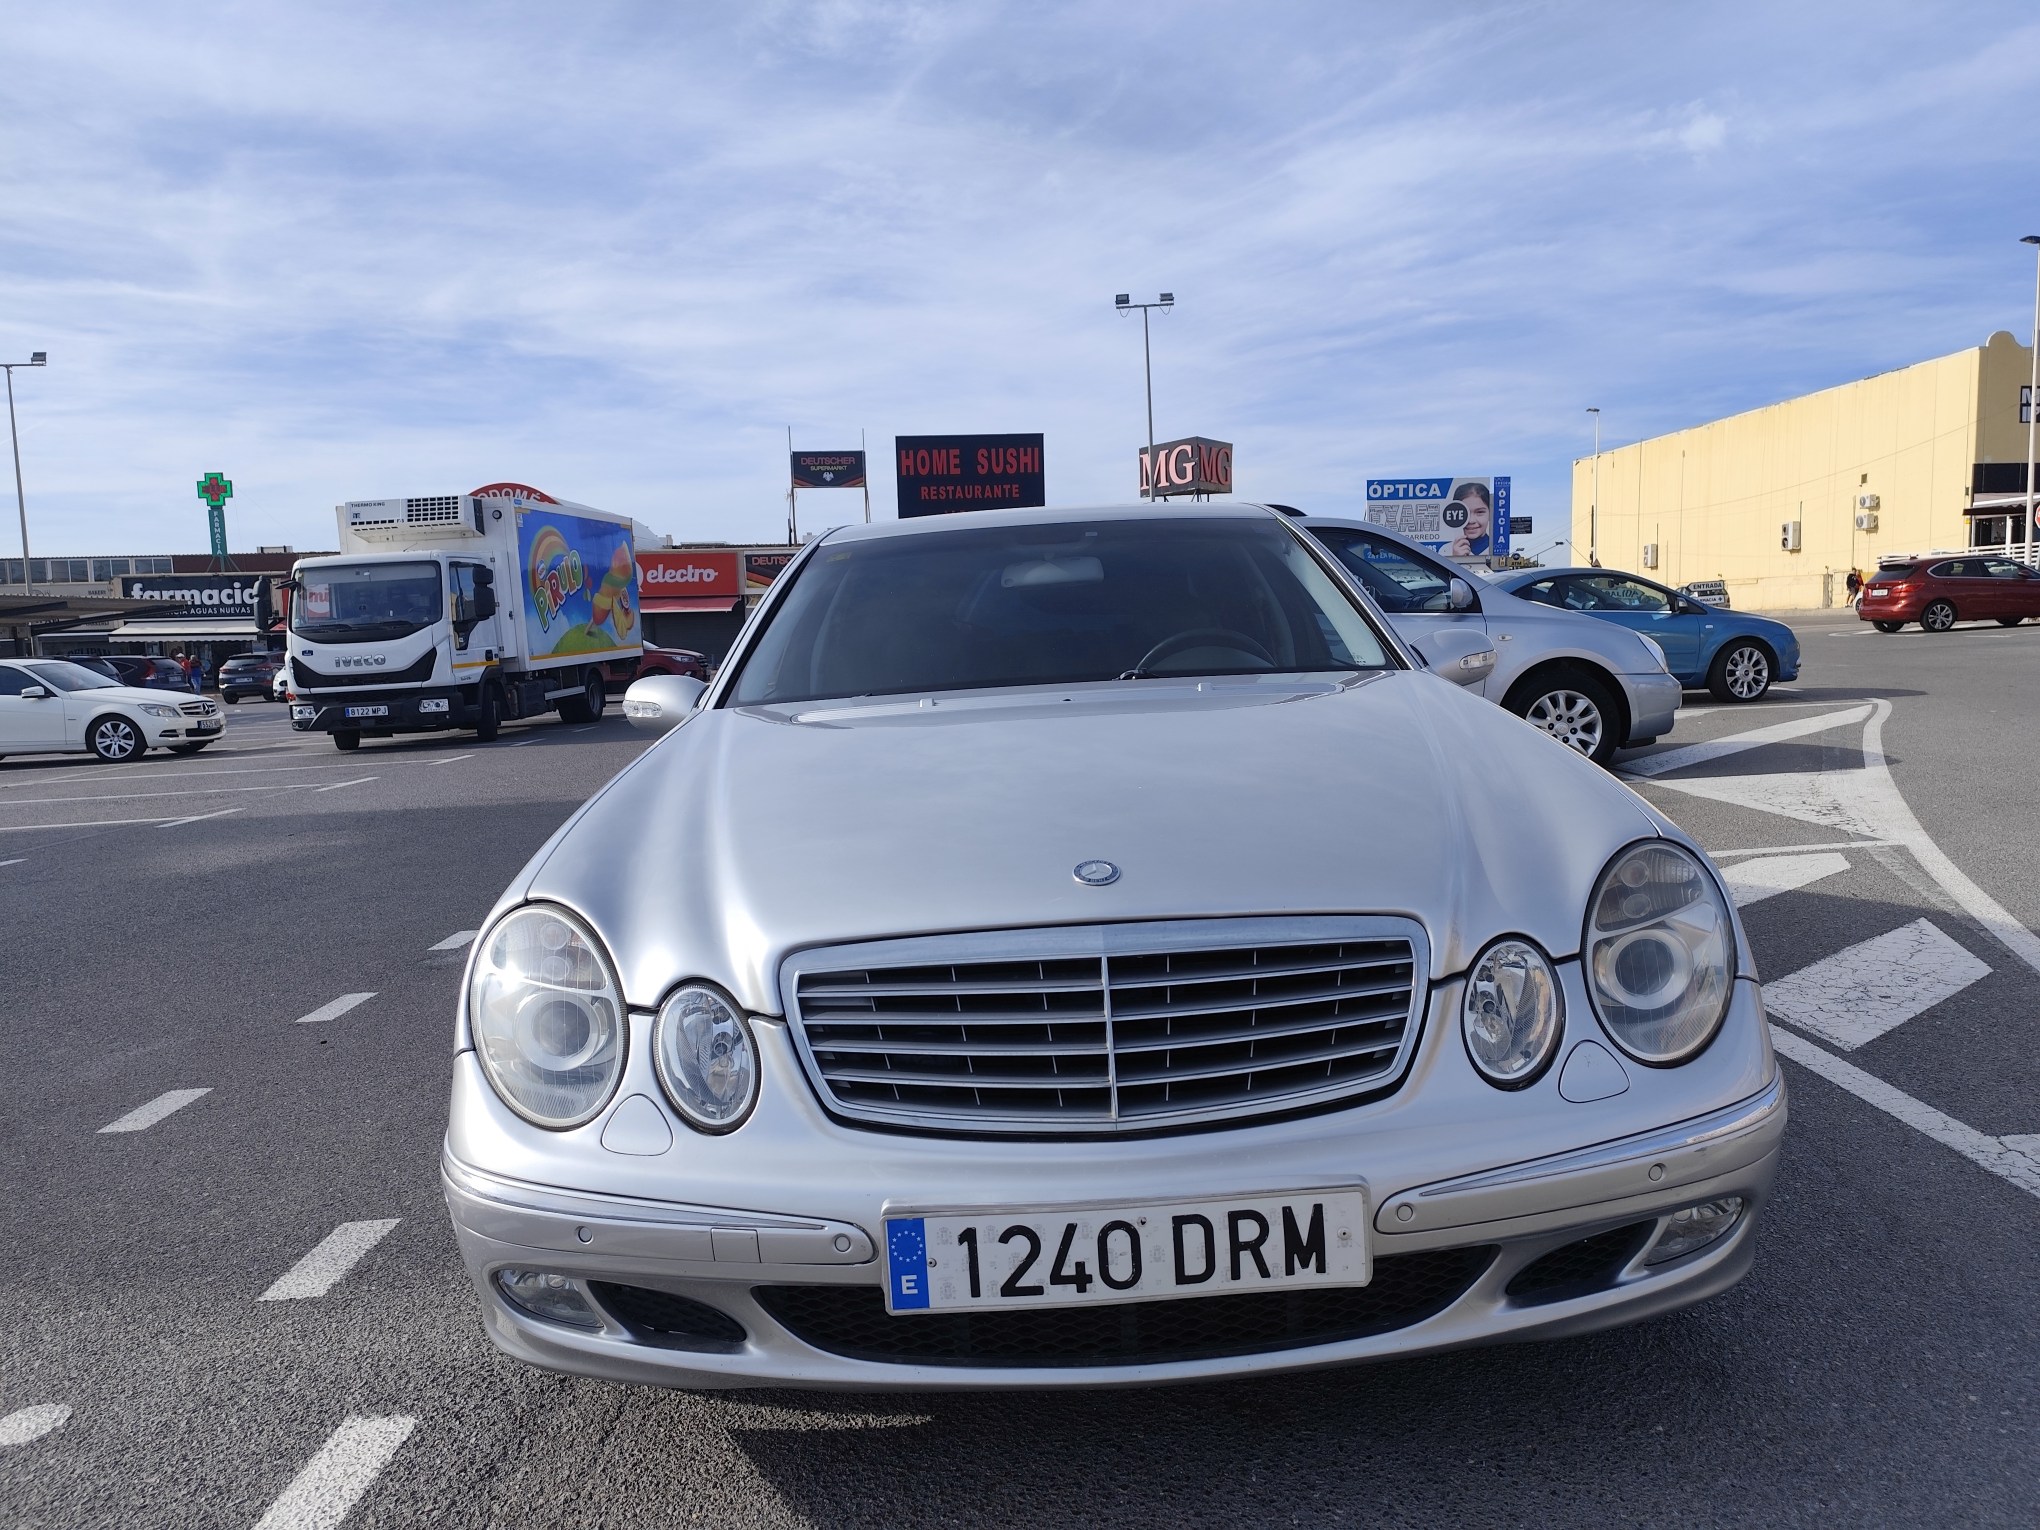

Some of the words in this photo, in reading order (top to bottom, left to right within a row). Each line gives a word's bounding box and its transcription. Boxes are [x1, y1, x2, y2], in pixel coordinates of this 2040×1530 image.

[801, 457, 856, 466] DEUTSCHER
[901, 448, 961, 476] HOME
[977, 447, 1039, 475] SUSHI
[1140, 444, 1196, 490] MG
[1198, 444, 1232, 486] MG
[921, 484, 1020, 500] RESTAURANTE
[1368, 481, 1442, 498] ÓPTICA
[1446, 510, 1464, 521] EYE
[213, 511, 223, 555] FARMACIA
[646, 563, 718, 583] electro
[1693, 582, 1722, 590] ENTRADA
[190, 607, 217, 615] AGUAS
[220, 606, 251, 614] NUEVAS
[335, 654, 386, 668] IVECO
[350, 707, 369, 716] 8122
[371, 706, 387, 715] MPJ
[957, 1219, 1143, 1299] 1240
[1171, 1203, 1327, 1286] DRM
[901, 1274, 918, 1295] E
